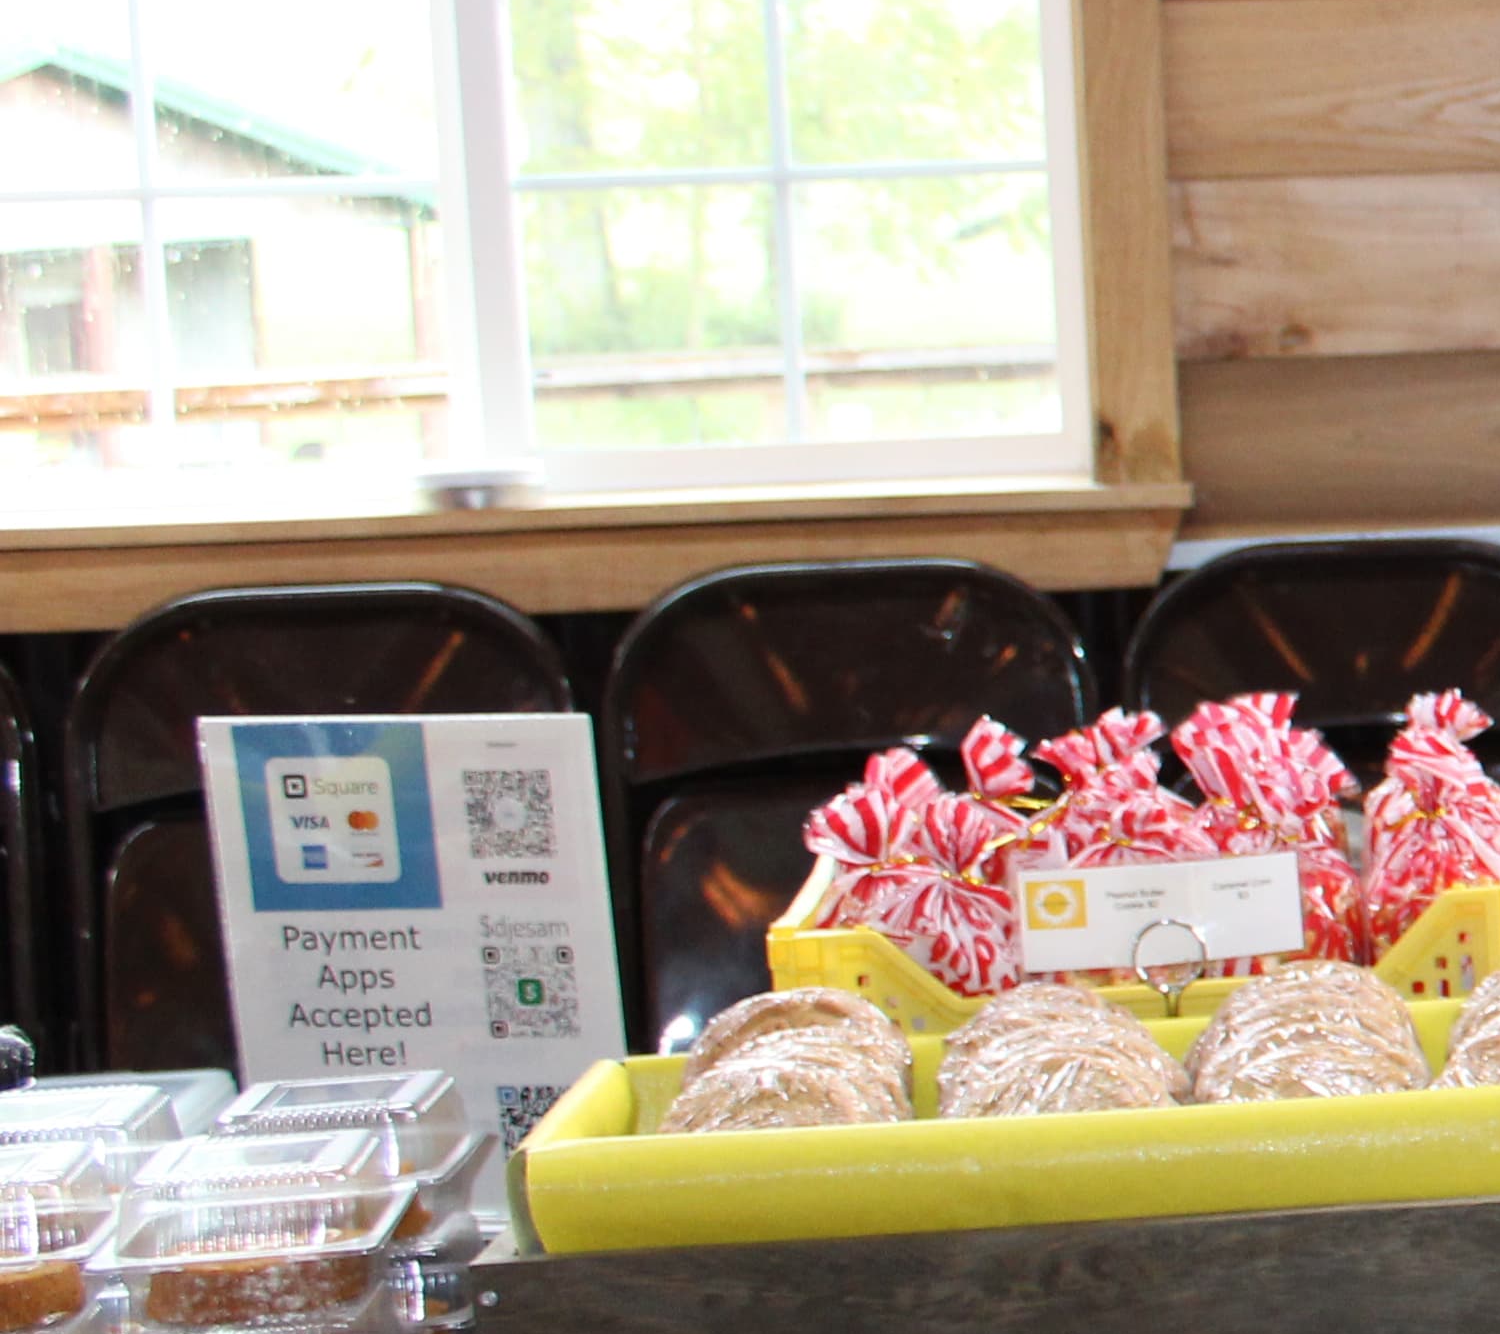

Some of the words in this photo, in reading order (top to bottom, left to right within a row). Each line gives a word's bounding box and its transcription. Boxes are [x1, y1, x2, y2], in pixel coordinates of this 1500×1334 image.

[314, 779, 379, 797] Square
[290, 816, 331, 829] VISA
[484, 871, 550, 884] venmo
[283, 925, 423, 956] Payment
[318, 965, 396, 995] Apps
[289, 1002, 433, 1034] Accepted
[321, 1041, 407, 1066] Here!
